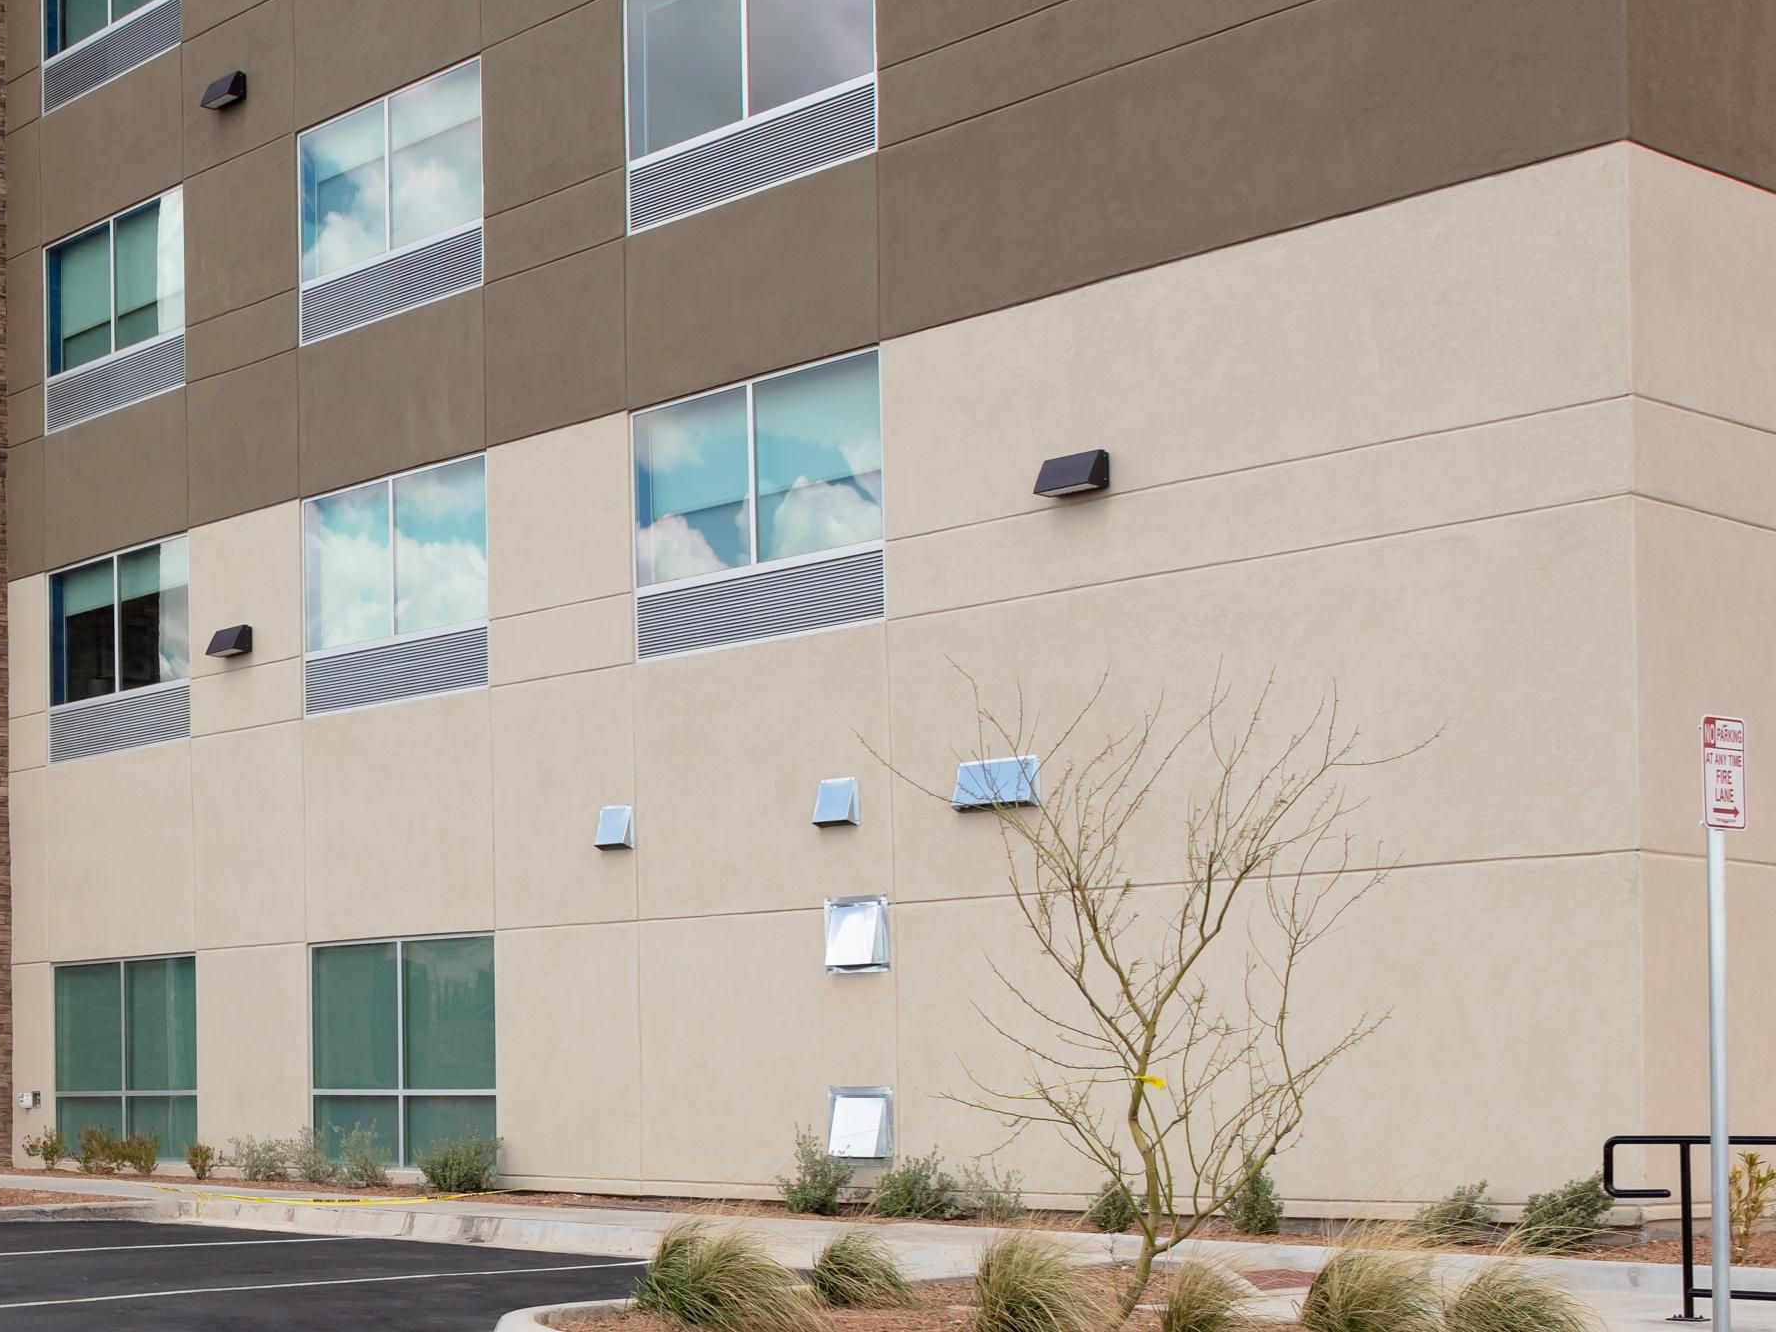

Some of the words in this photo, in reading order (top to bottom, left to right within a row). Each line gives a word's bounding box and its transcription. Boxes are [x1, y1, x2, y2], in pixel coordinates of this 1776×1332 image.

[1704, 723, 1715, 744] NO
[1717, 728, 1743, 744] PARKING
[1705, 752, 1713, 765] AT
[1714, 753, 1728, 766] ANY
[1728, 754, 1742, 768] TIME
[1716, 769, 1733, 785] FIRE
[1715, 787, 1734, 803] LANE
